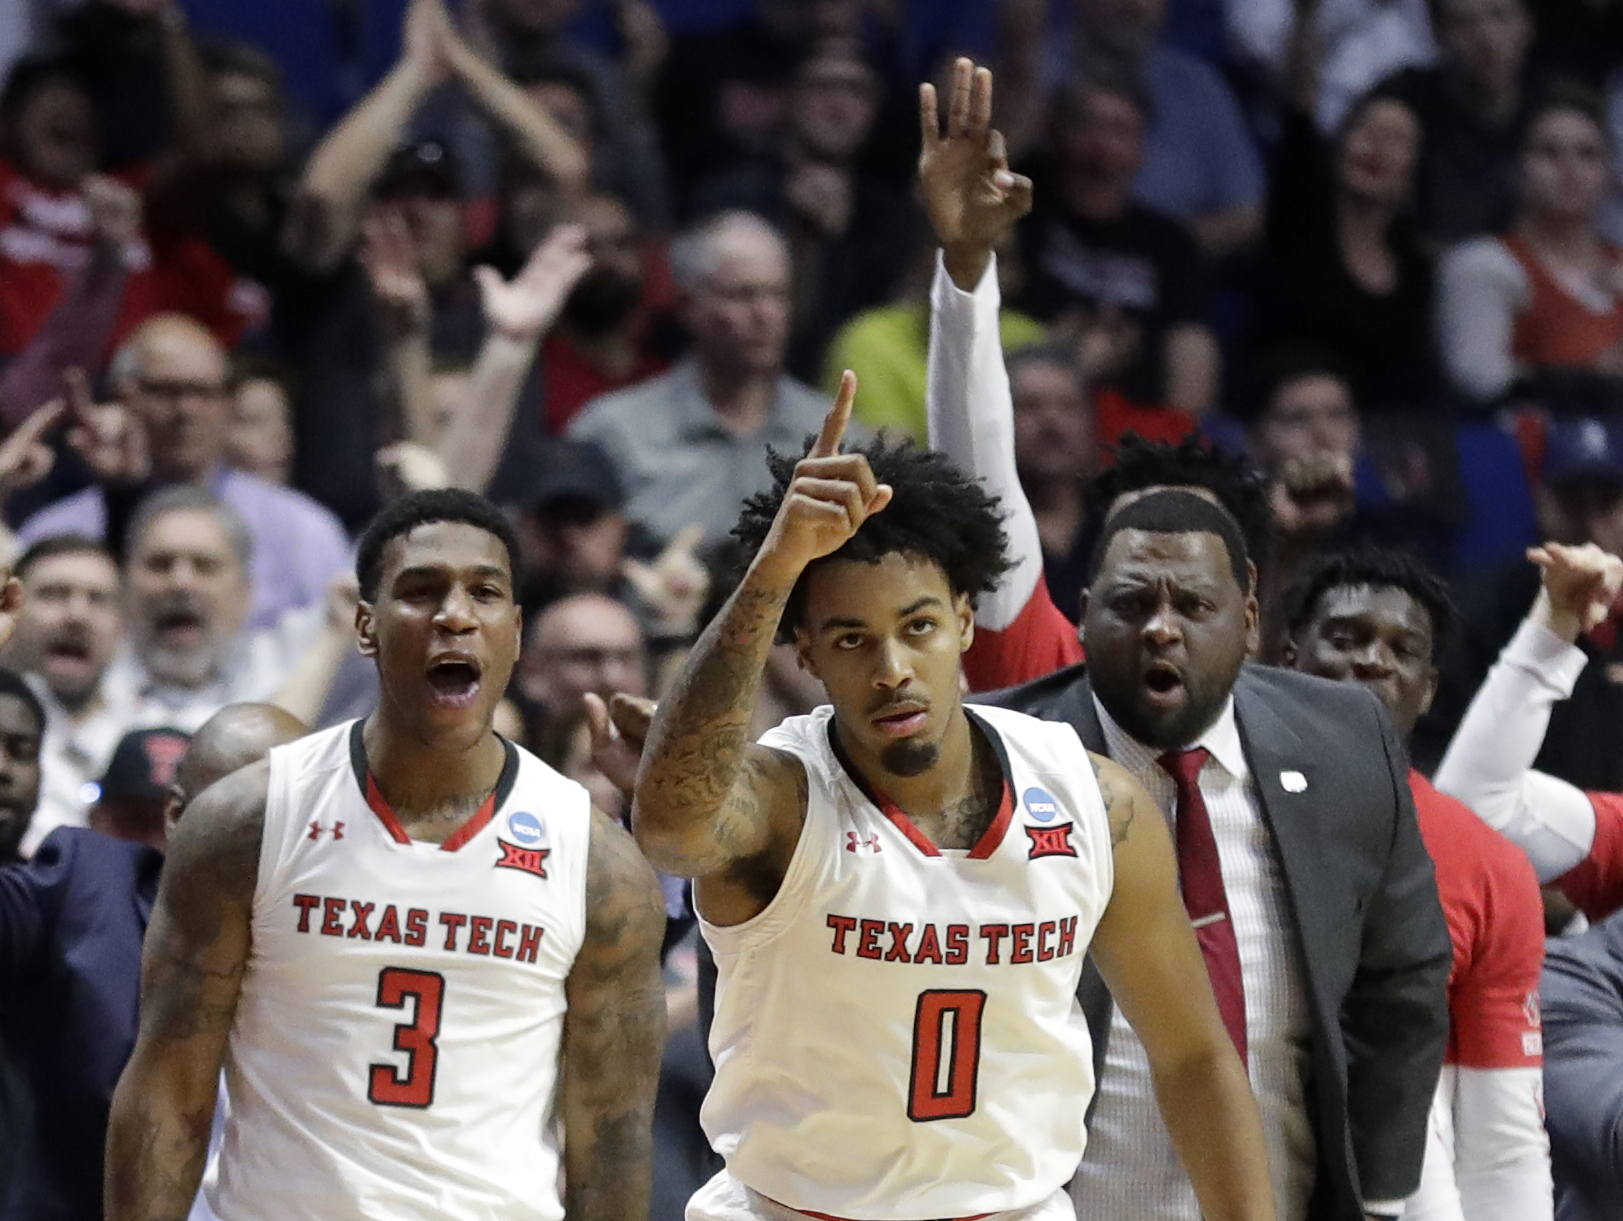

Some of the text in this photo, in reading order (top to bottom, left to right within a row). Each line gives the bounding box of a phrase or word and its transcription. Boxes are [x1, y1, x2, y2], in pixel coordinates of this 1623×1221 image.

[293, 894, 544, 964] TEXAS TECH
[826, 914, 1078, 965] TEXAS TECH
[367, 966, 446, 1110] 3
[907, 989, 988, 1122] 0
